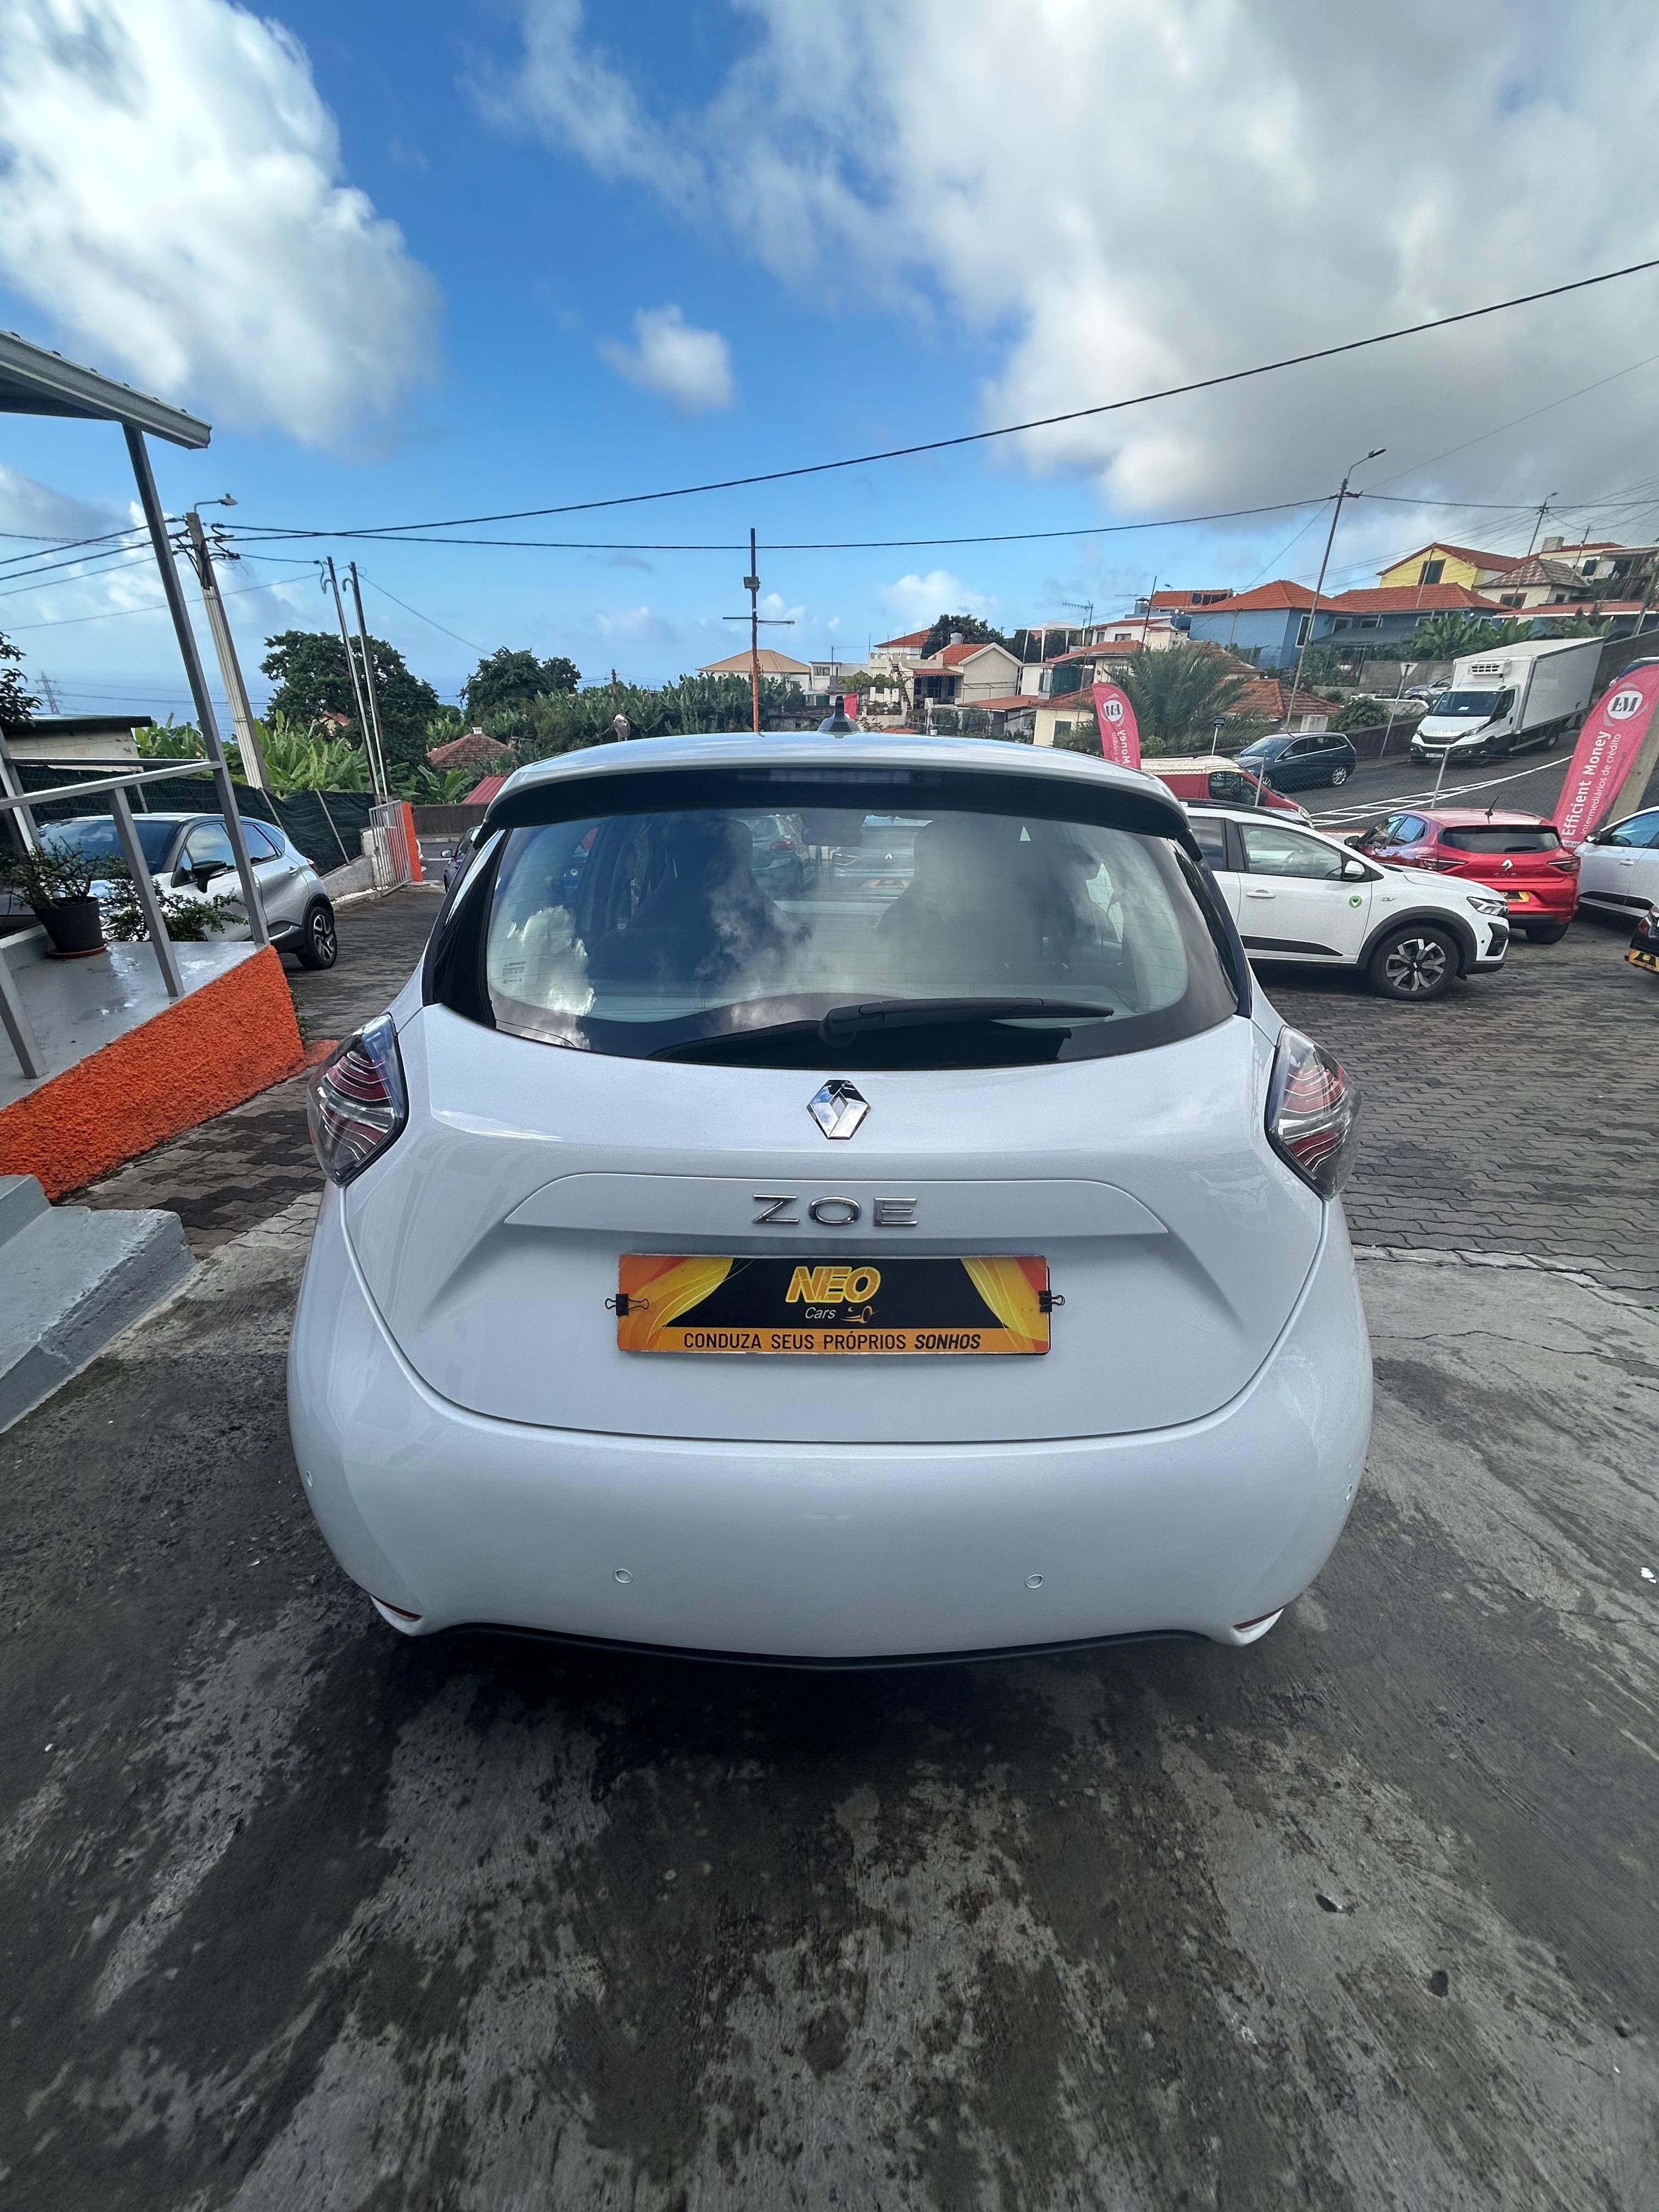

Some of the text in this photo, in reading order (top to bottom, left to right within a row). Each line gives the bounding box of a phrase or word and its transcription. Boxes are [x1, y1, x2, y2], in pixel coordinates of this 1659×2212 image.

[1610, 697, 1640, 712] EM
[1600, 765, 1611, 776] de
[1606, 733, 1622, 764] crédito
[1561, 780, 1592, 836] Efficient
[1582, 730, 1612, 776] Money
[752, 1194, 918, 1227] ZOE
[785, 1266, 881, 1304] NEO
[805, 1306, 837, 1319] Cars
[684, 1330, 981, 1350] CONDUZA SEUS PRÓPRIOS SONHOS
